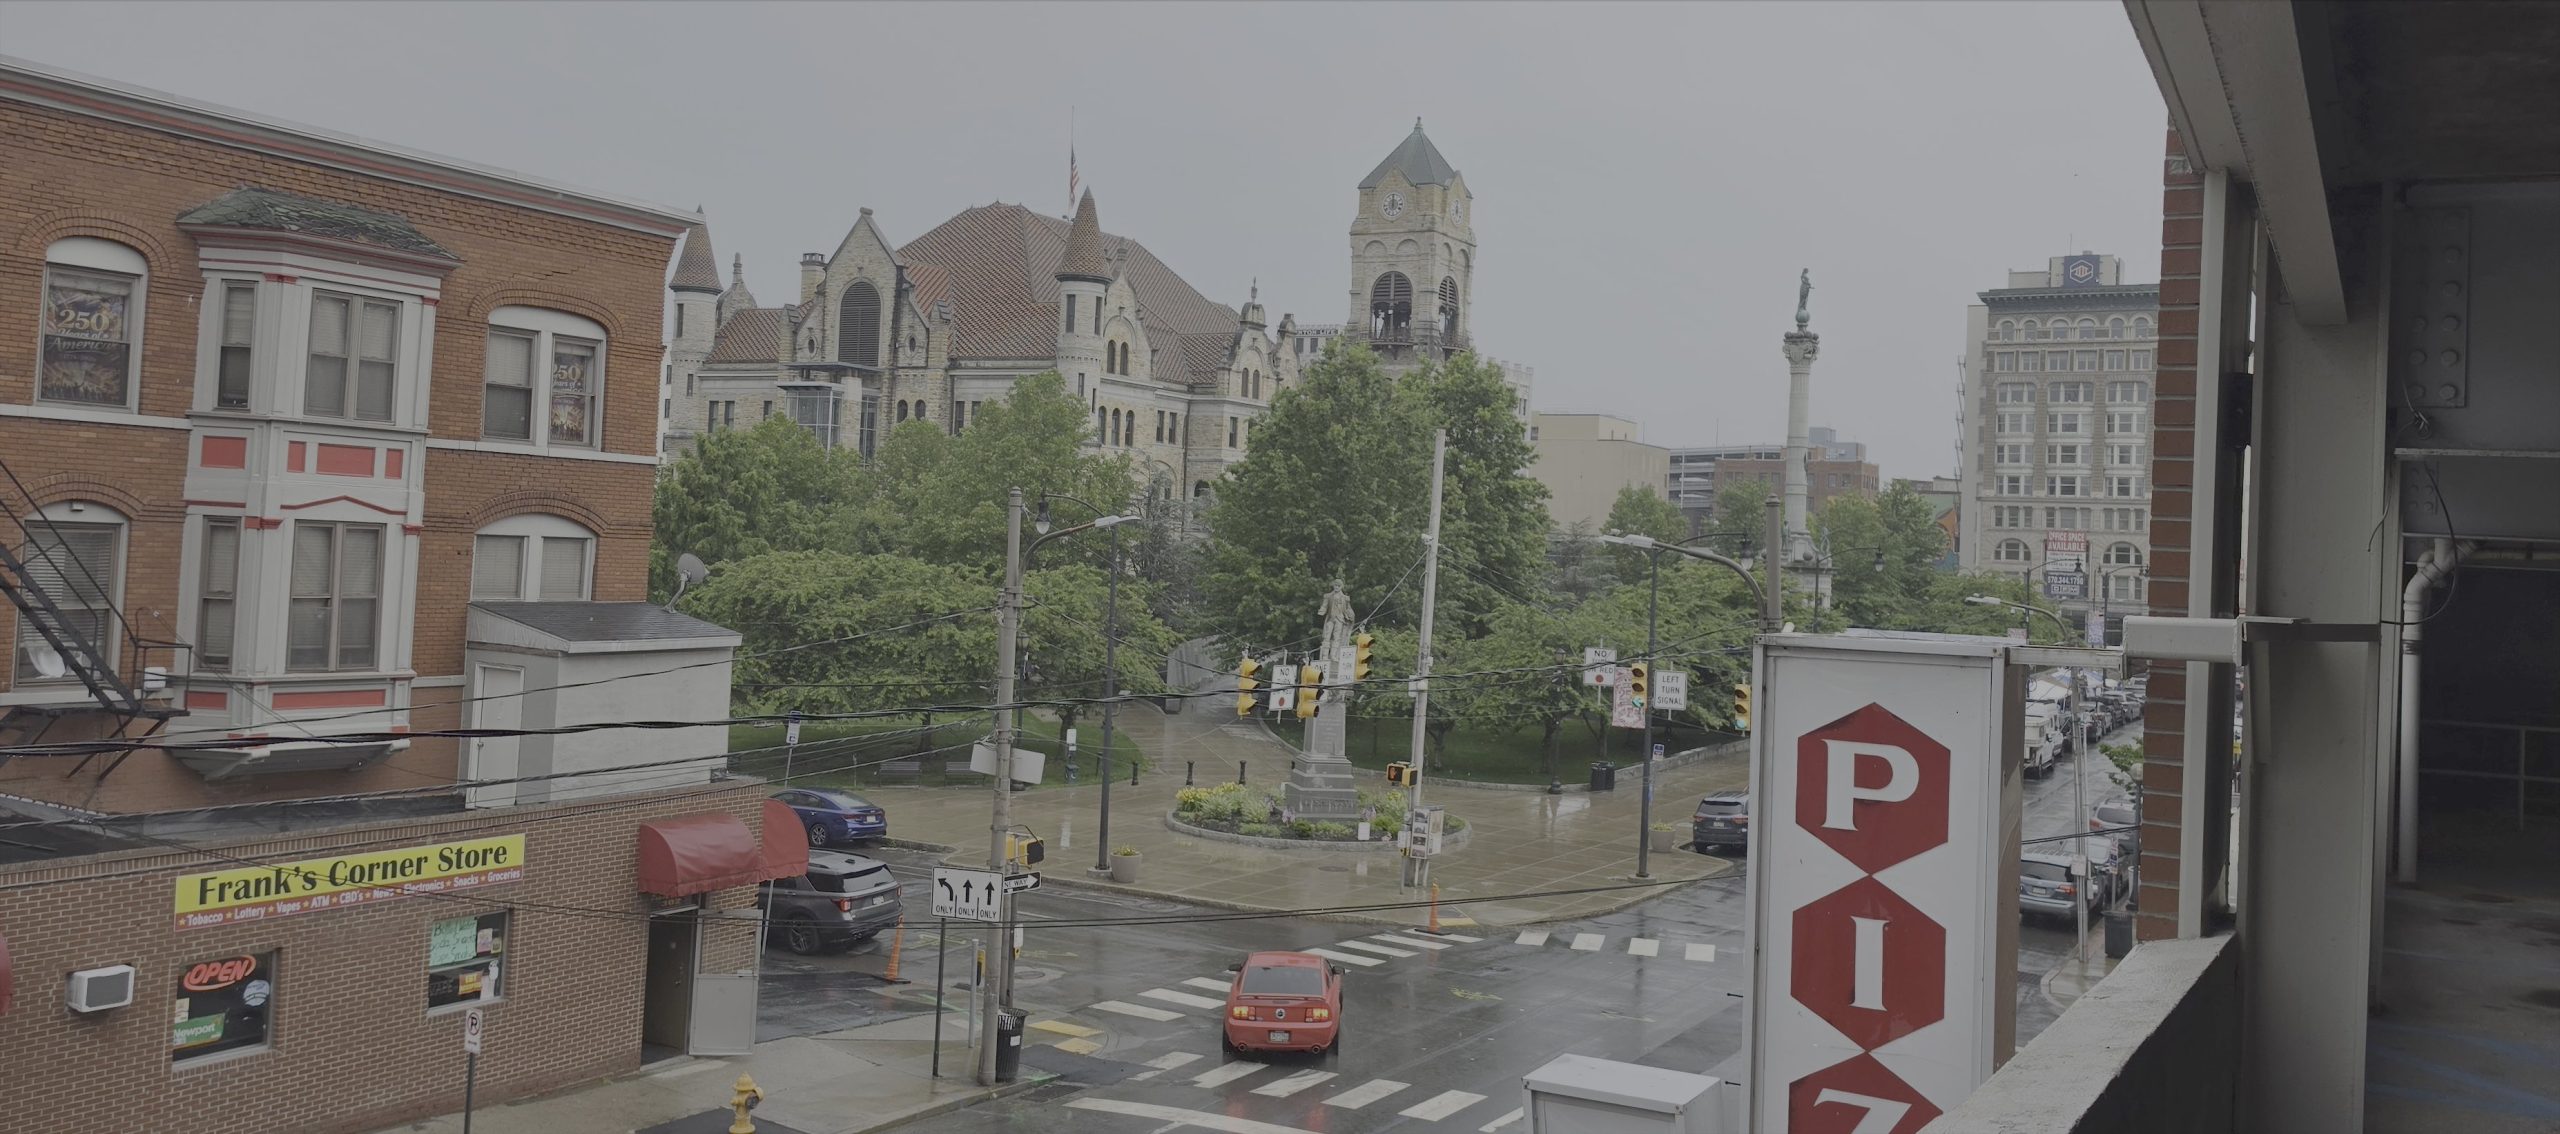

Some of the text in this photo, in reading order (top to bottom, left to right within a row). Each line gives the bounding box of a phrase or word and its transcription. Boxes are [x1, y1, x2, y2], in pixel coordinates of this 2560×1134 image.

[57, 309, 110, 331] 250
[58, 328, 90, 338] Years
[49, 337, 112, 352] America
[2048, 531, 2085, 541] OFFICE SPACE
[2047, 541, 2086, 552] AVAILABLE
[1280, 668, 1290, 676] NO
[1661, 686, 1680, 694] TURN
[1657, 697, 1683, 705] SIGNAL
[199, 845, 507, 905] Frank's Corner Store
[187, 868, 521, 926] Tobacco Lottery Vapes ATM CBD's News Electronics Snacks Groceries
[935, 905, 953, 914] ONLY
[958, 907, 975, 916] ONLY
[980, 909, 997, 919] ONLY
[189, 960, 250, 985] OPEN
[173, 1023, 216, 1038] Newport
